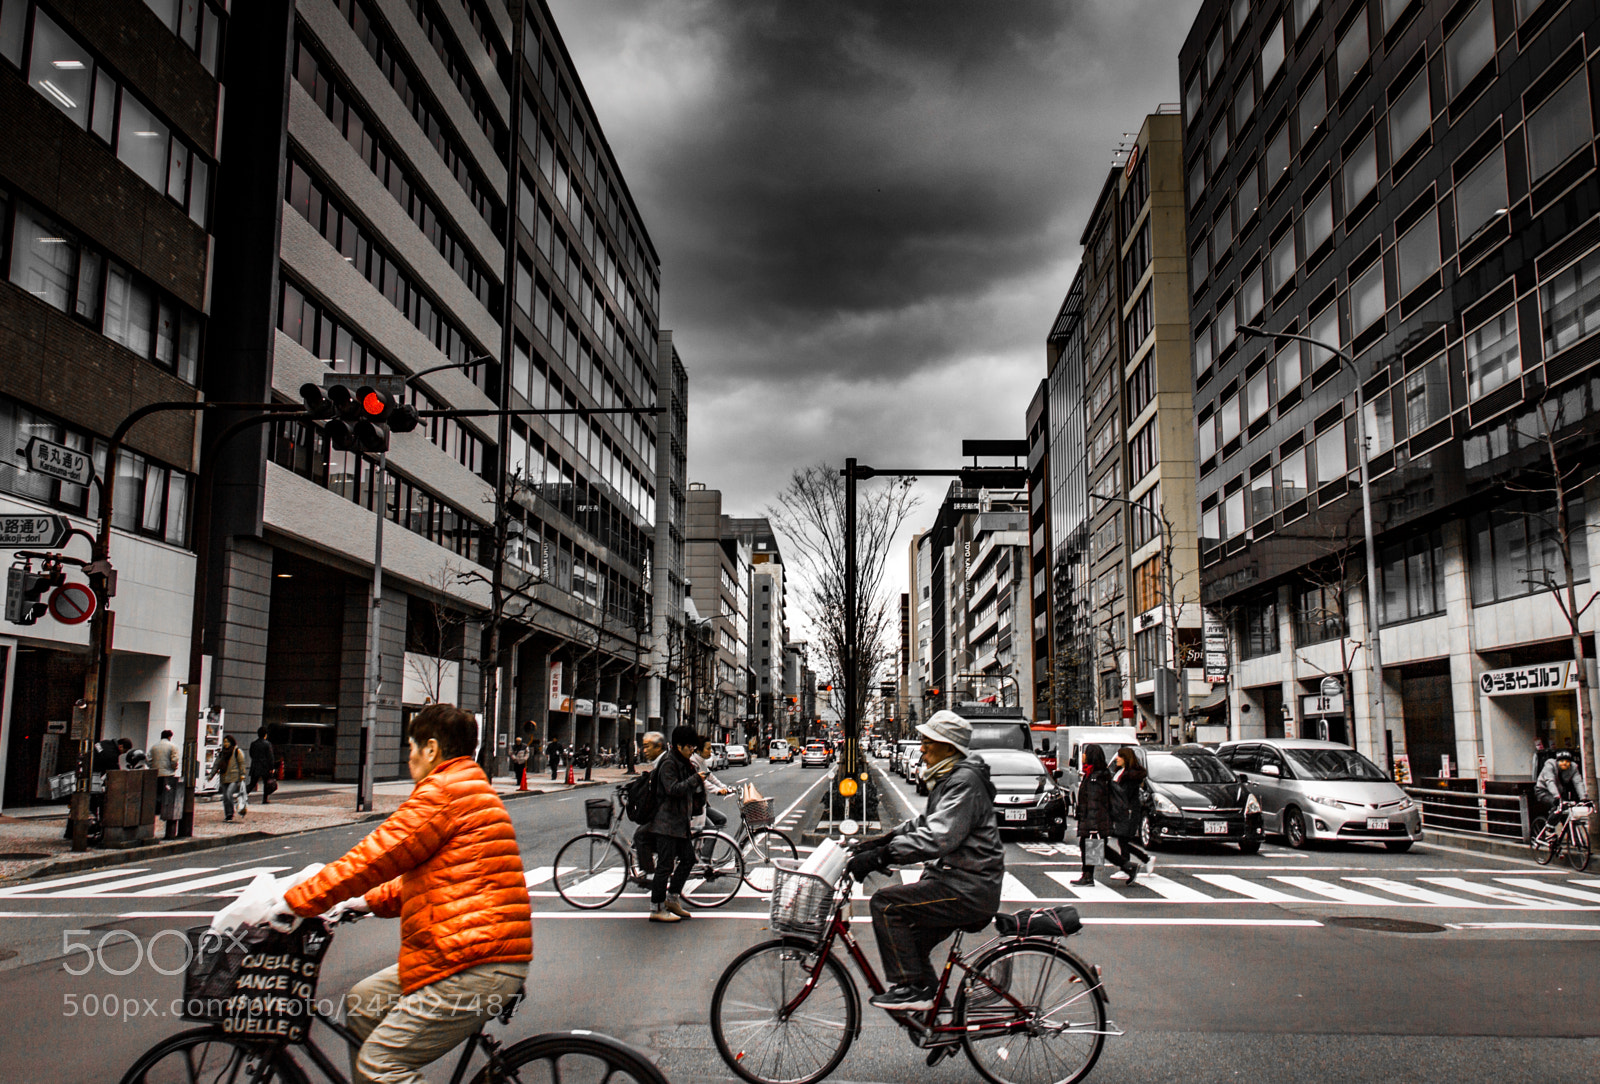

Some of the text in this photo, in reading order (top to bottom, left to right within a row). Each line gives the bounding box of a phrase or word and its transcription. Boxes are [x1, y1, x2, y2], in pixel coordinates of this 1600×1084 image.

[38, 444, 83, 471] 烏丸通り
[40, 460, 81, 481] Karasuma-dori
[1494, 667, 1560, 691] つるやゴルフ
[241, 953, 300, 973] QUELLE
[222, 1016, 289, 1036] QUELLE
